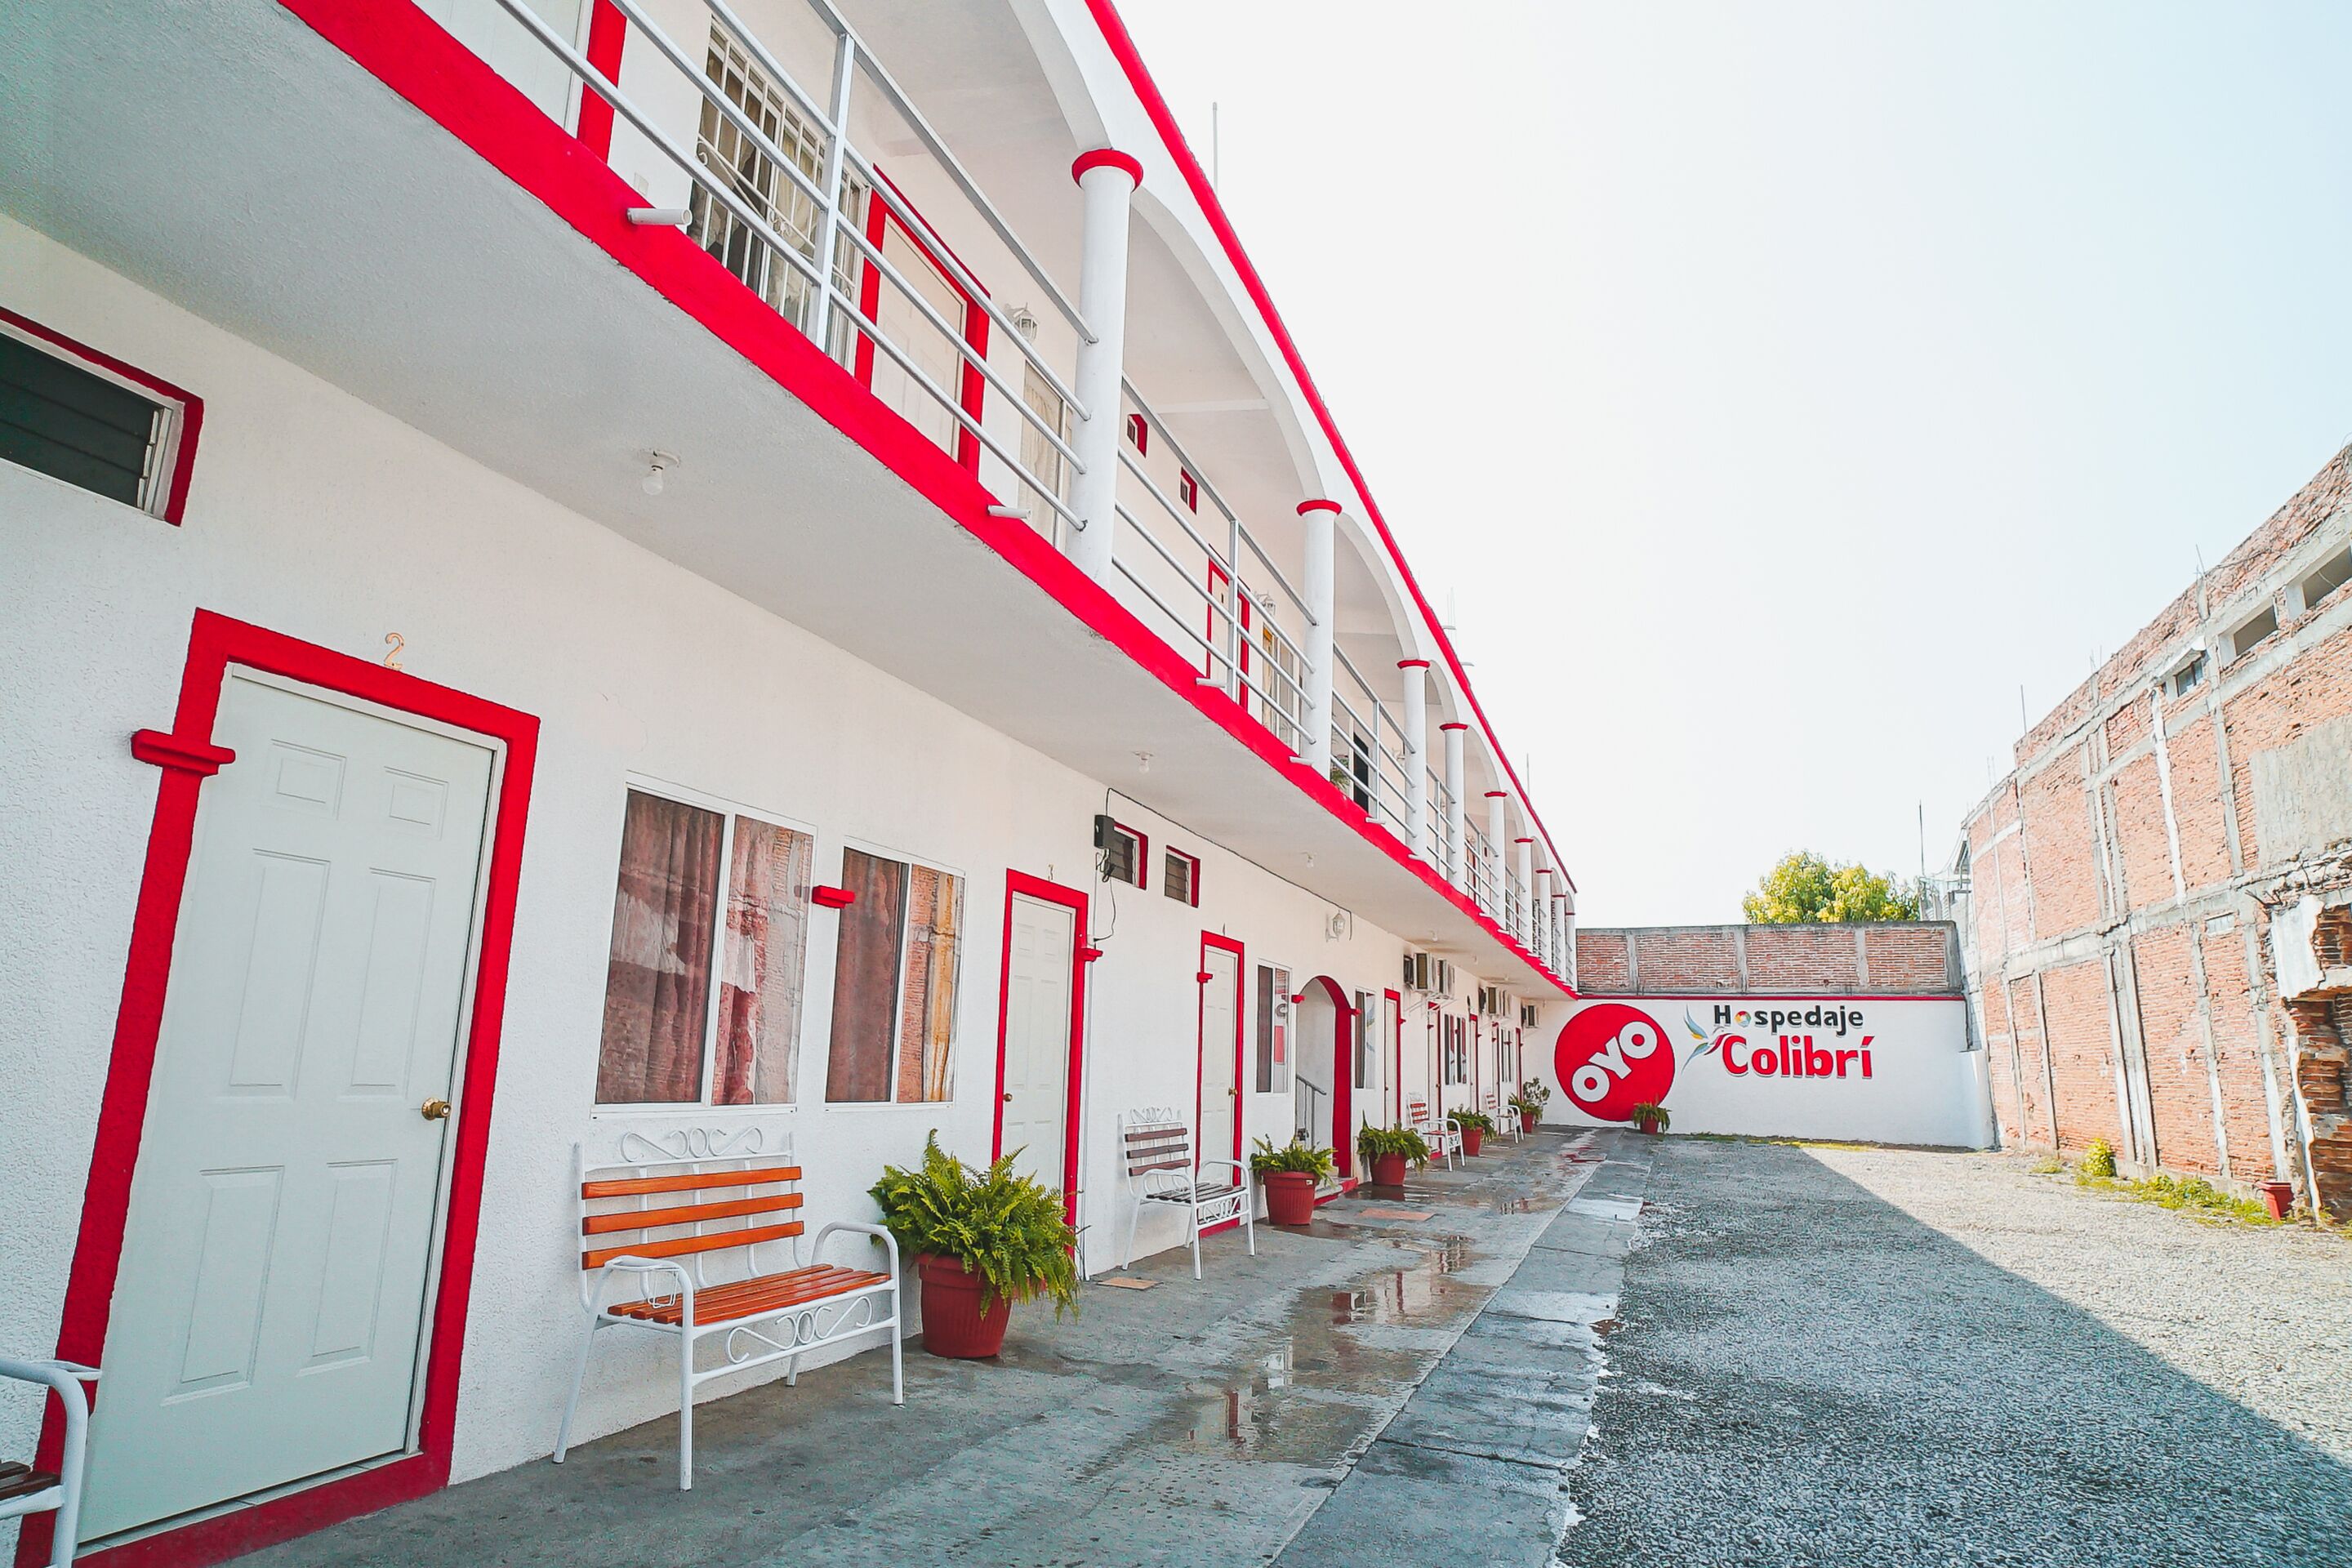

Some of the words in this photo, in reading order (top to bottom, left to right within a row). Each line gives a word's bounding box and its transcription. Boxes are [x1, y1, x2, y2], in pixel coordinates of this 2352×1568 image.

[384, 632, 404, 670] 2
[1714, 1004, 1864, 1036] Hospedaje
[1571, 1021, 1658, 1102] OYO
[1722, 1035, 1875, 1078] Colibrí
